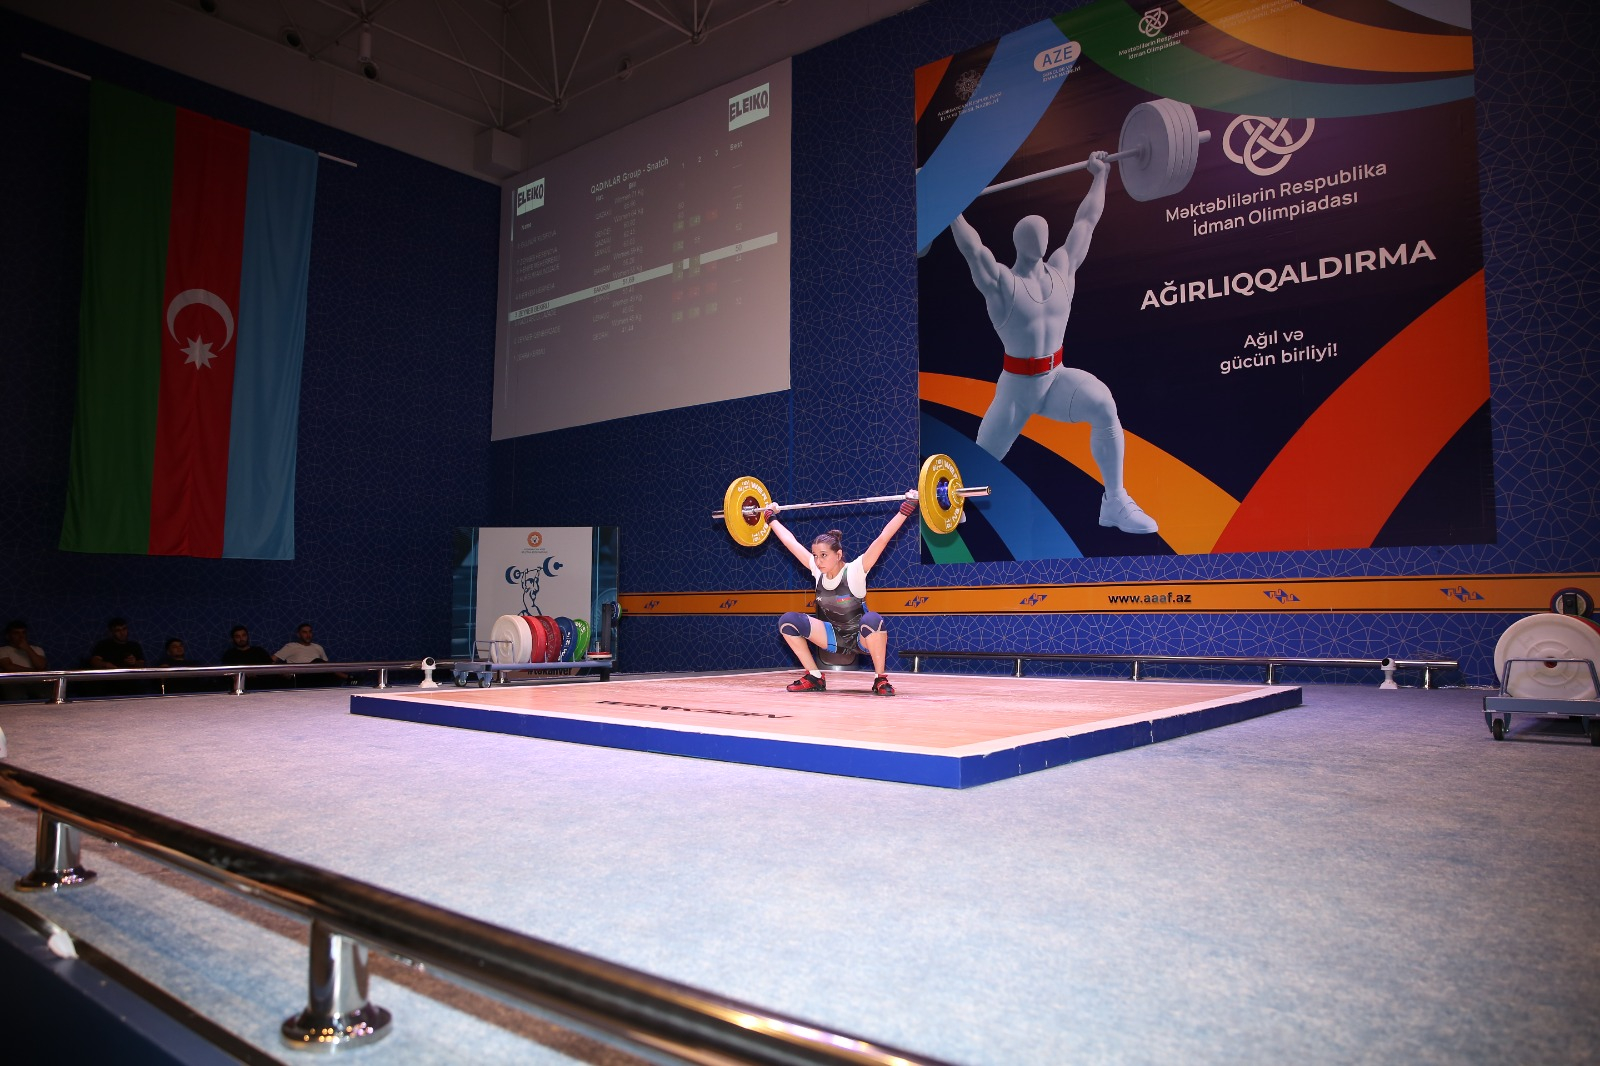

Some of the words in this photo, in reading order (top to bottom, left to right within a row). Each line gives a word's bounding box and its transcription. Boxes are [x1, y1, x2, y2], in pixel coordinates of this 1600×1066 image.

[1043, 45, 1073, 67] AZE
[730, 90, 768, 122] ELEIKO
[622, 169, 642, 182] Group
[646, 156, 669, 172] Snatch
[518, 184, 544, 208] ELEIKO
[1166, 187, 1276, 222] Məktəblilərin
[1280, 163, 1387, 198] Respublika
[1192, 214, 1245, 237] İdman
[1248, 191, 1358, 224] Olimpiadası
[1140, 239, 1436, 310] AĞIRLIQQALDIRMA
[1244, 330, 1278, 349] Ağıl
[1282, 330, 1304, 345] və
[1220, 352, 1276, 374] gücün
[1281, 343, 1338, 364] birliyi!
[1108, 592, 1191, 603] www.aaaf.az
